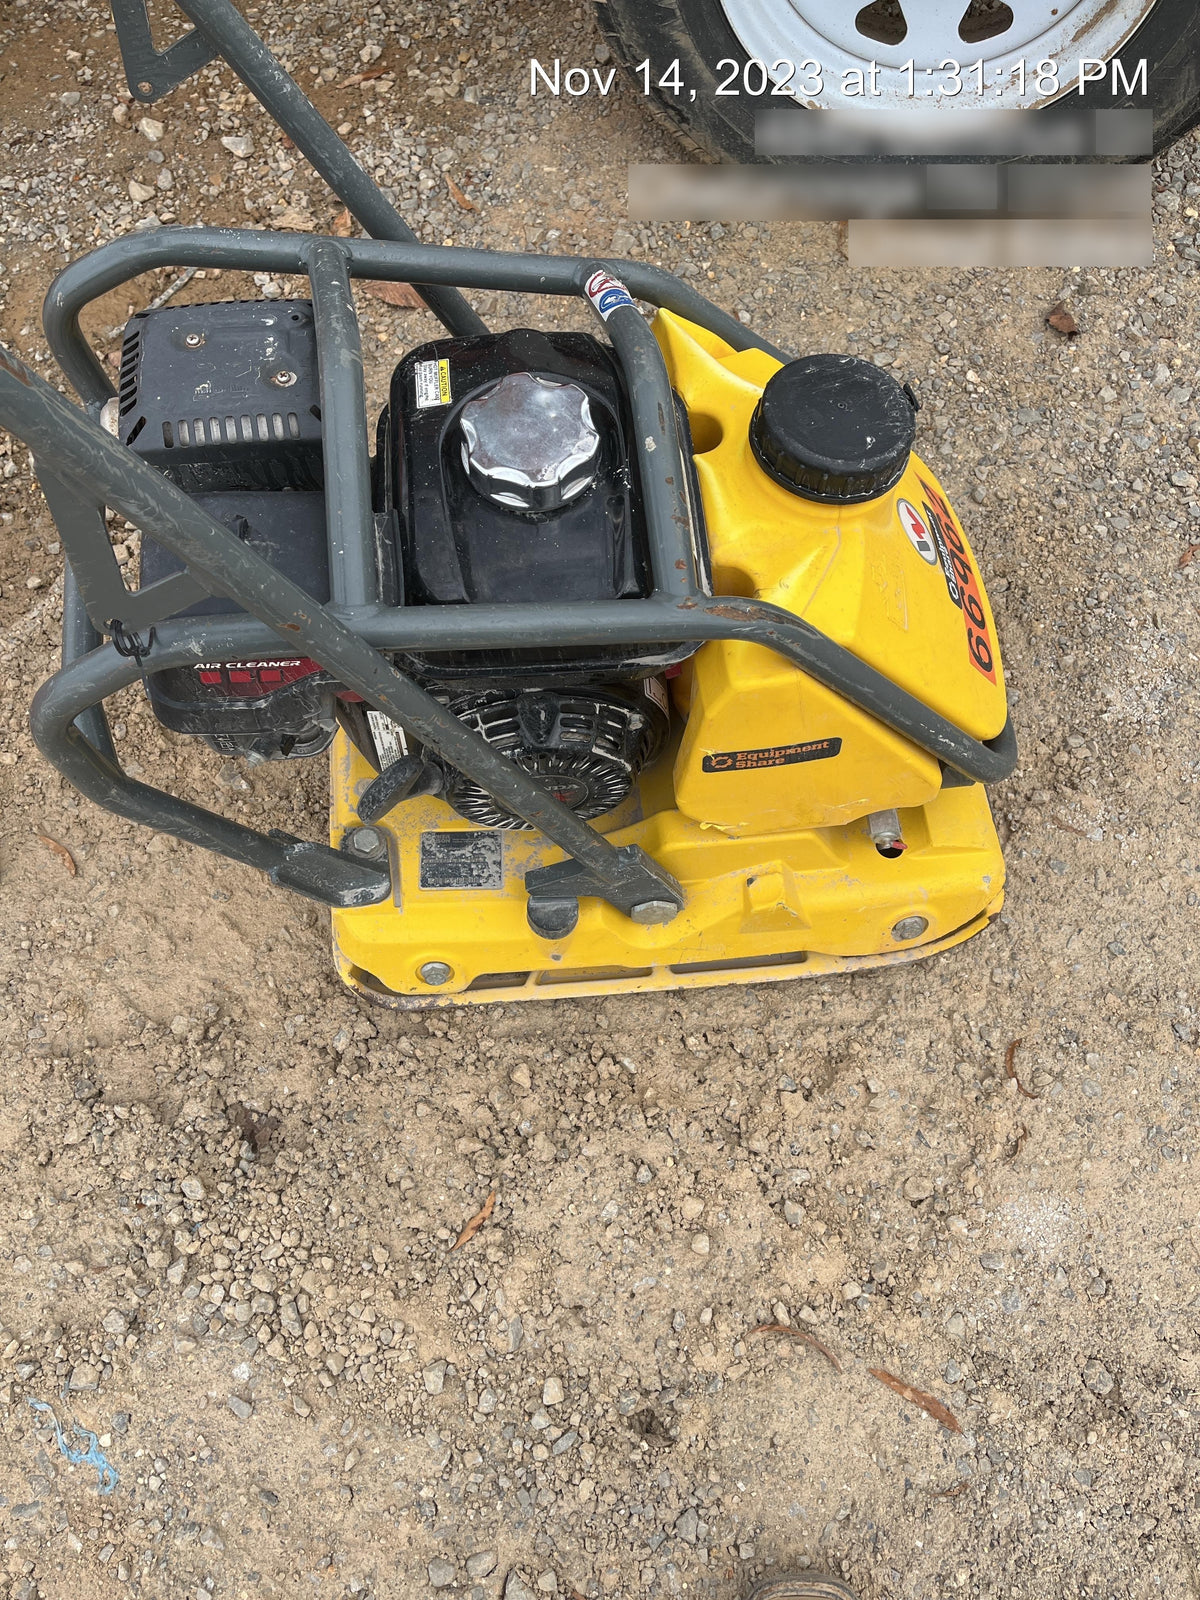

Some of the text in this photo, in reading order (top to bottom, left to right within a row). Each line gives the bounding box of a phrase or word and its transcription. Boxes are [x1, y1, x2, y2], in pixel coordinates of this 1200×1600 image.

[440, 371, 448, 397] CAUTION
[225, 660, 301, 669] CLEANER
[736, 741, 829, 761] Equipment
[735, 757, 785, 769] Share
